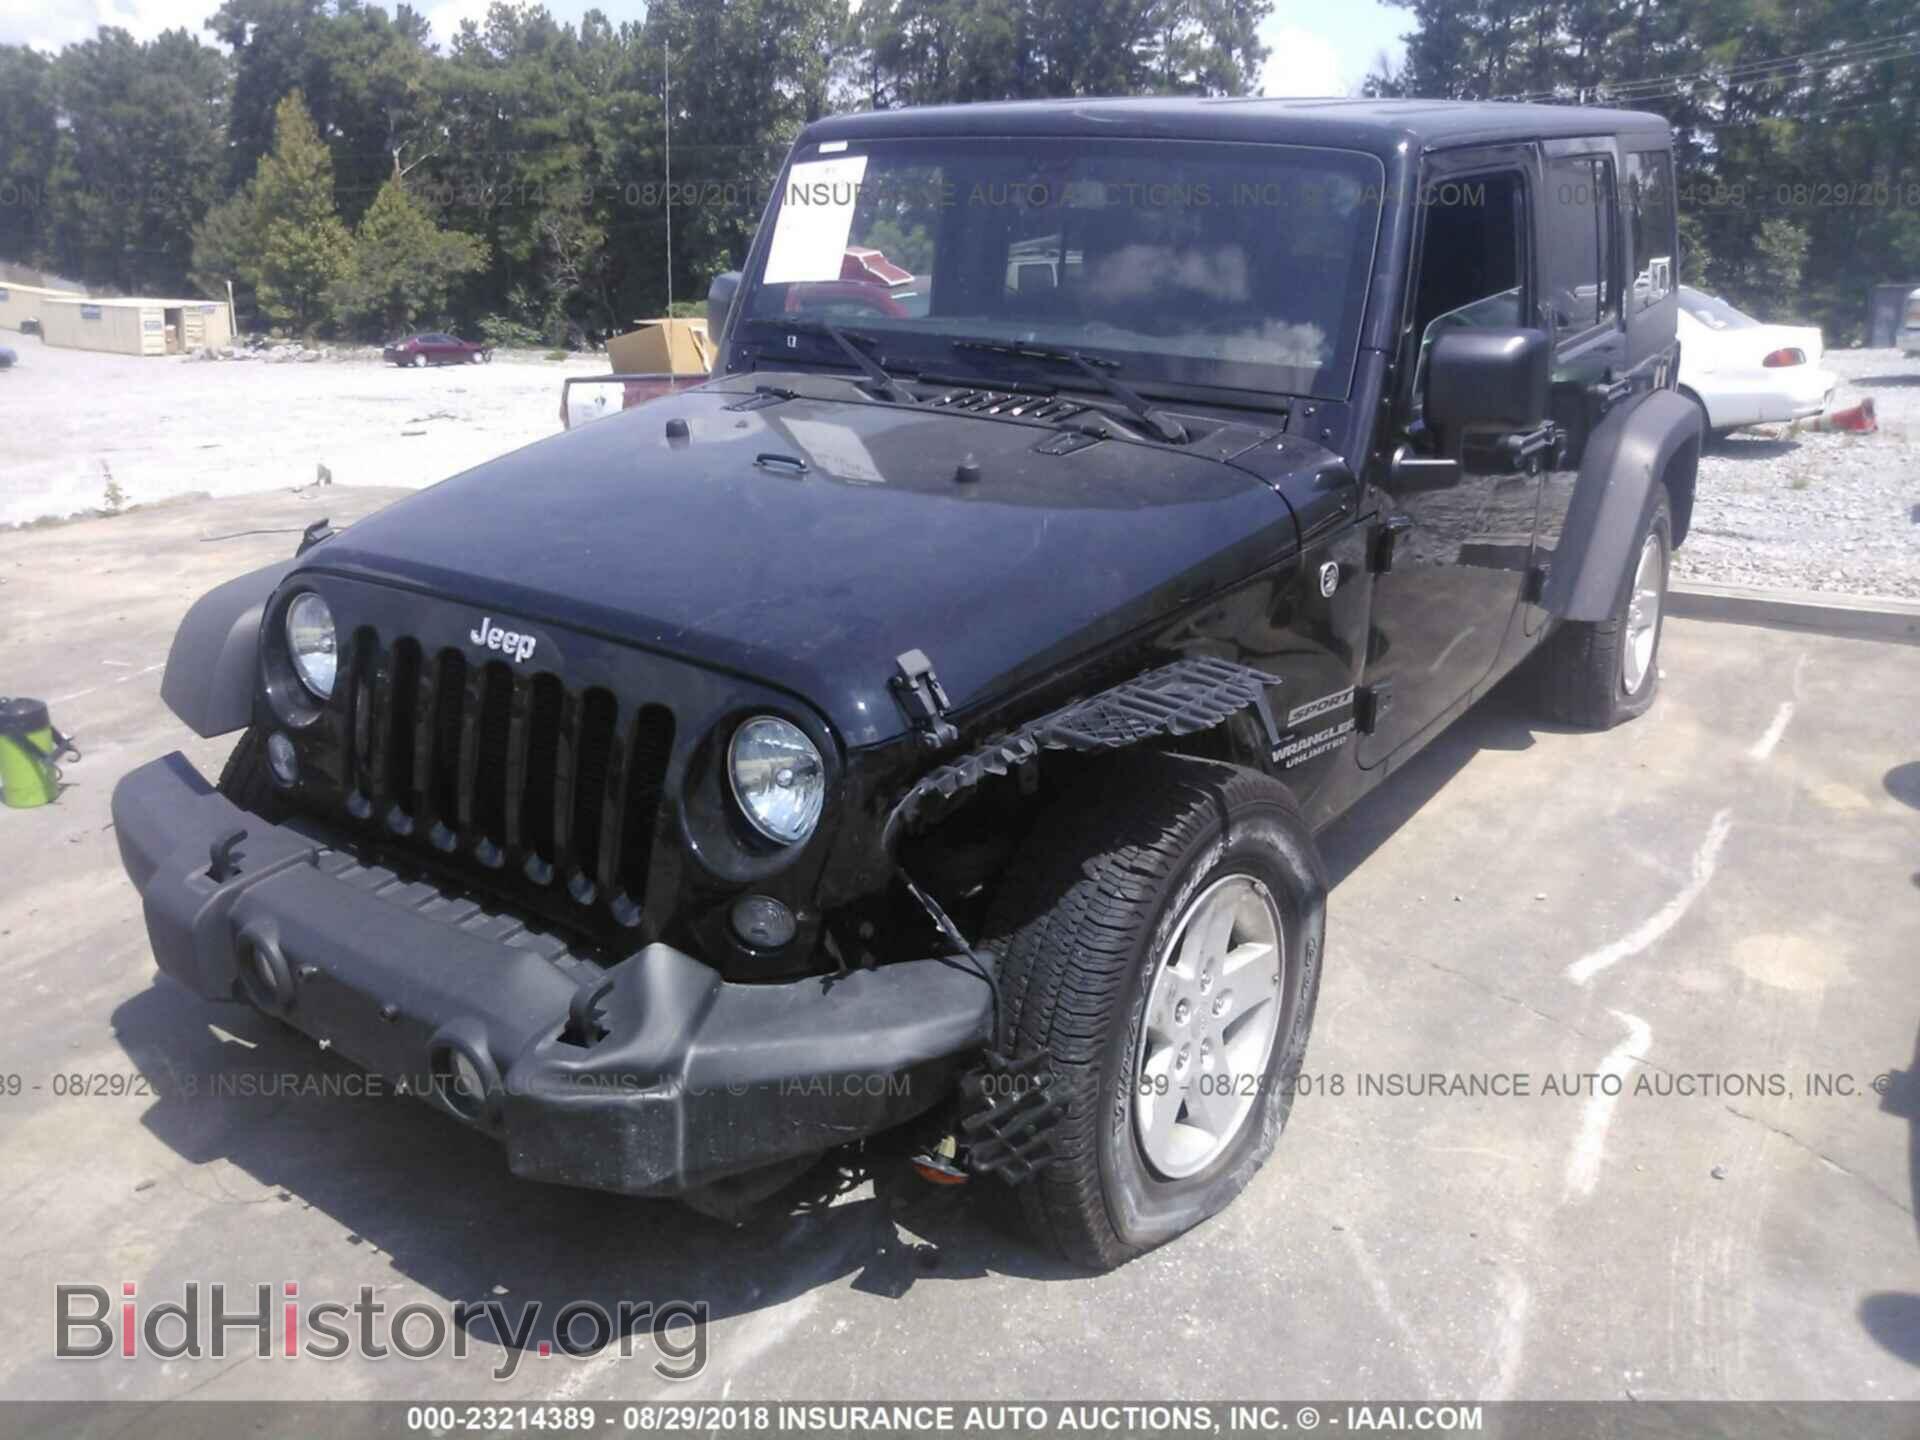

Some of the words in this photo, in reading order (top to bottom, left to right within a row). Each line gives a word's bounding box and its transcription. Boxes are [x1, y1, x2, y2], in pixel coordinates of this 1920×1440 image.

[470, 616, 536, 663] Jeep
[1292, 689, 1354, 720] SPORT
[1271, 717, 1355, 763] WRANGLER
